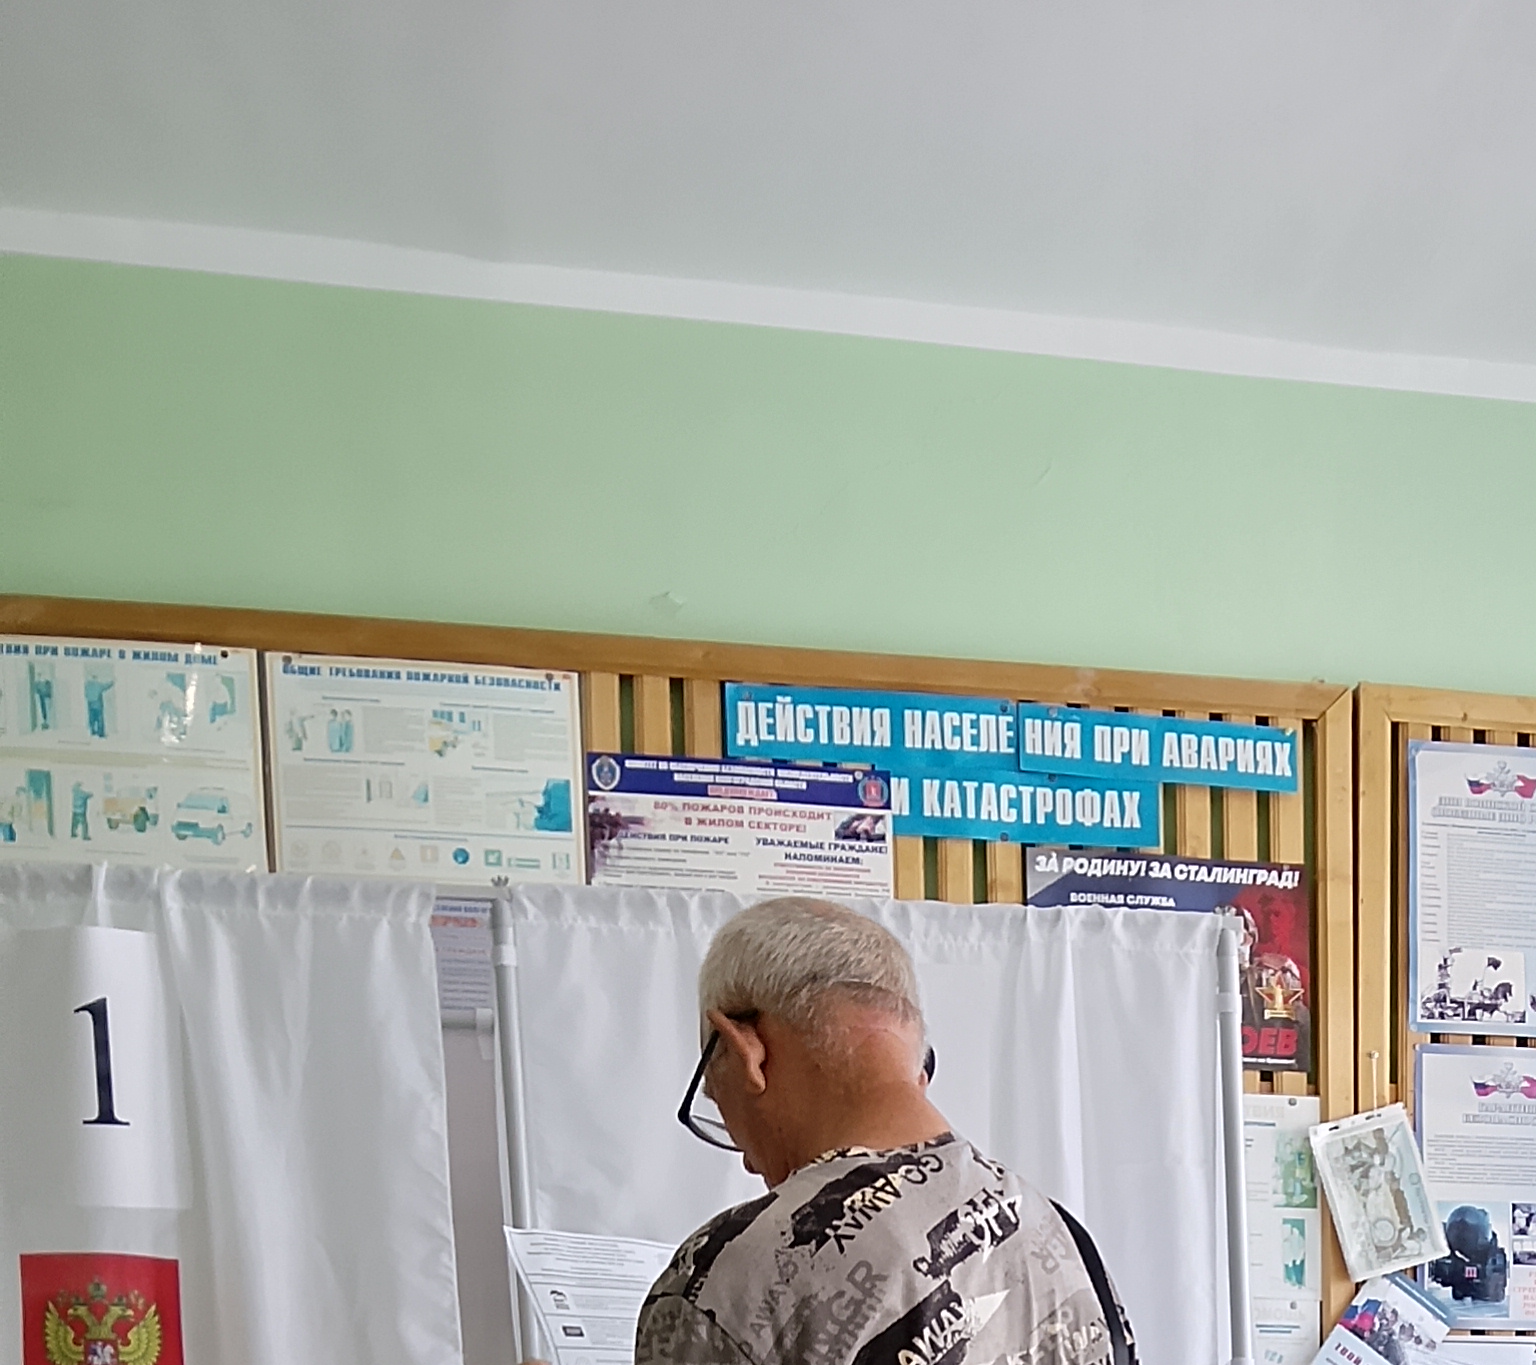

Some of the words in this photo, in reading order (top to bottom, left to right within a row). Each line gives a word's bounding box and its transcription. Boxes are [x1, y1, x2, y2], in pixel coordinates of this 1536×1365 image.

[34, 644, 59, 656] ПРИ
[64, 646, 112, 659] ПОЖАРЕ
[132, 650, 179, 662] ЖИЛОМ
[282, 663, 322, 677] ОБЩИЕ
[328, 666, 402, 681] ТРЕБОВАНИЯ
[406, 671, 469, 684] ПОЖАРНОЙ
[474, 675, 562, 692] БЕЗОПАСНОСТИ
[736, 697, 891, 747] ДЕЙСТВИЯ
[1094, 724, 1150, 766] ПРИ
[1162, 732, 1293, 778] АВАРИЯХ
[682, 802, 745, 816] ПОЖАРОВ
[749, 806, 832, 821] ПРОИСХОДИТ
[890, 780, 909, 816] И
[922, 781, 1141, 829] КАТАСТРОФАХ
[684, 816, 692, 826] В
[697, 817, 745, 830] ЖИЛОМ
[748, 820, 807, 834] СЕКТОРЕ!
[669, 833, 688, 843] ПРИ
[690, 835, 730, 846] ПОЖАРЕ
[755, 837, 825, 851] УВАЖАЕМЫЕ
[784, 850, 863, 866] НАПОМИНАЕМ:
[1034, 855, 1059, 873] ЗА
[1062, 858, 1147, 878] РОДИНУ!
[1149, 861, 1172, 880] ЗА
[1174, 864, 1300, 890] СТАЛИНГРАД!
[1069, 892, 1124, 904] ВОЕННАЯ
[1126, 895, 1176, 908] СЛУЖБА
[74, 997, 130, 1126] 1
